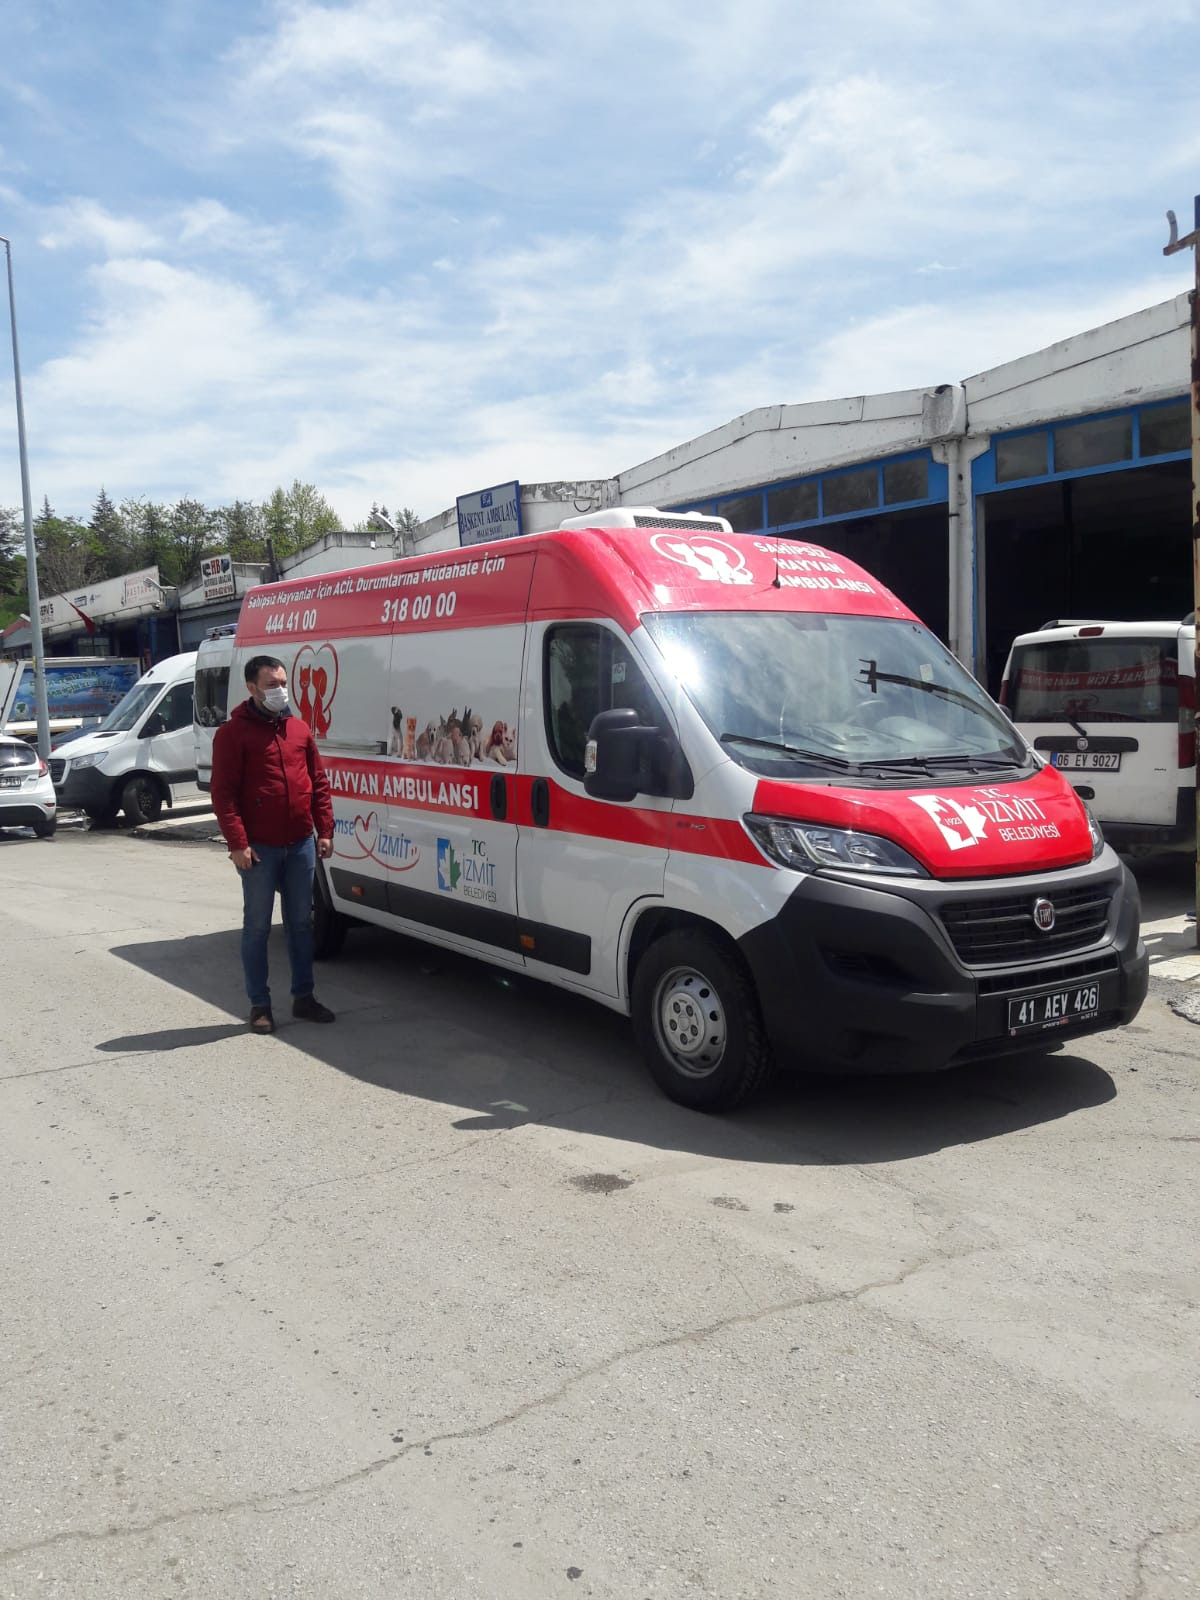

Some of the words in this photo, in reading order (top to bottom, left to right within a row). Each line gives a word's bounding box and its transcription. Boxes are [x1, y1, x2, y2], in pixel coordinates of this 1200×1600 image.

[753, 542, 831, 558] SAHİPSİZ
[773, 558, 845, 574] HAYVAN
[248, 590, 275, 609] Sahipsiz
[277, 587, 316, 607] Hayvanlar
[317, 581, 332, 600] İçin
[333, 580, 353, 596] ACİL
[356, 571, 419, 593] Durumlarına
[422, 560, 479, 583] Müdahale
[481, 552, 505, 576] İçin
[778, 575, 876, 594] AMBULANSI
[381, 599, 408, 623] 318
[412, 594, 432, 620] 00
[435, 591, 457, 617] 00
[265, 613, 284, 633] 444
[286, 611, 300, 630] 41
[302, 609, 317, 630] 00
[1057, 754, 1069, 766] 06
[1075, 754, 1089, 767] EY
[1092, 754, 1118, 768] 9027
[326, 769, 379, 796] HAYVAN
[383, 775, 479, 810] AMBULANSI
[974, 788, 1010, 799] TC
[975, 796, 1046, 823] İZMİT
[945, 817, 963, 826] 1923
[998, 822, 1061, 842] BELEDİYESİ
[378, 828, 412, 860] İZMİT
[471, 839, 486, 856] TC
[463, 853, 496, 887] İZMİT
[464, 886, 497, 903] BELEDİYESİ
[1040, 908, 1052, 923] FIAT
[1019, 1001, 1035, 1023] 41
[1045, 993, 1068, 1018] AEV
[1074, 986, 1097, 1010] 426
